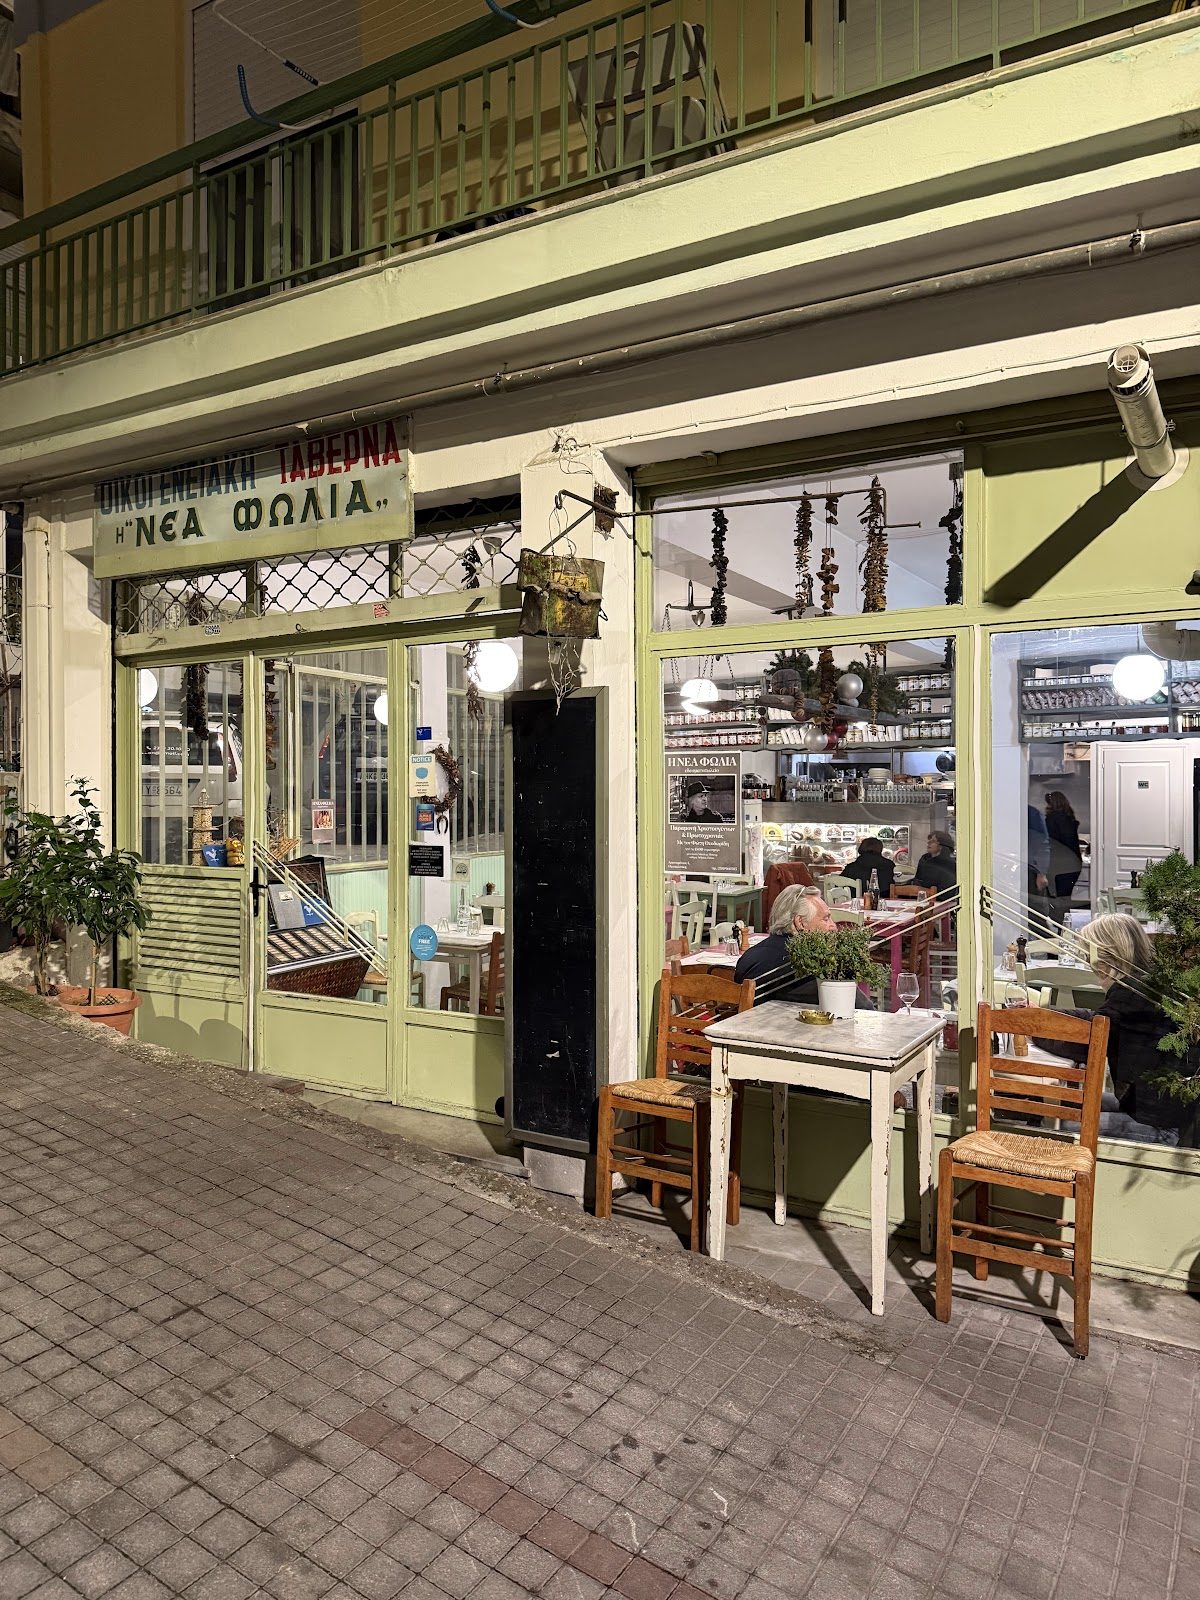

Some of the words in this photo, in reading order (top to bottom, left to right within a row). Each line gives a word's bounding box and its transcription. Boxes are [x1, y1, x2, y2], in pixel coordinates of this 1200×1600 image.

[275, 420, 402, 485] ΤΑΒΕΡΝΑ
[677, 757, 698, 767] ΝΕΑ
[699, 756, 737, 767] ΦΩΛΙΑ
